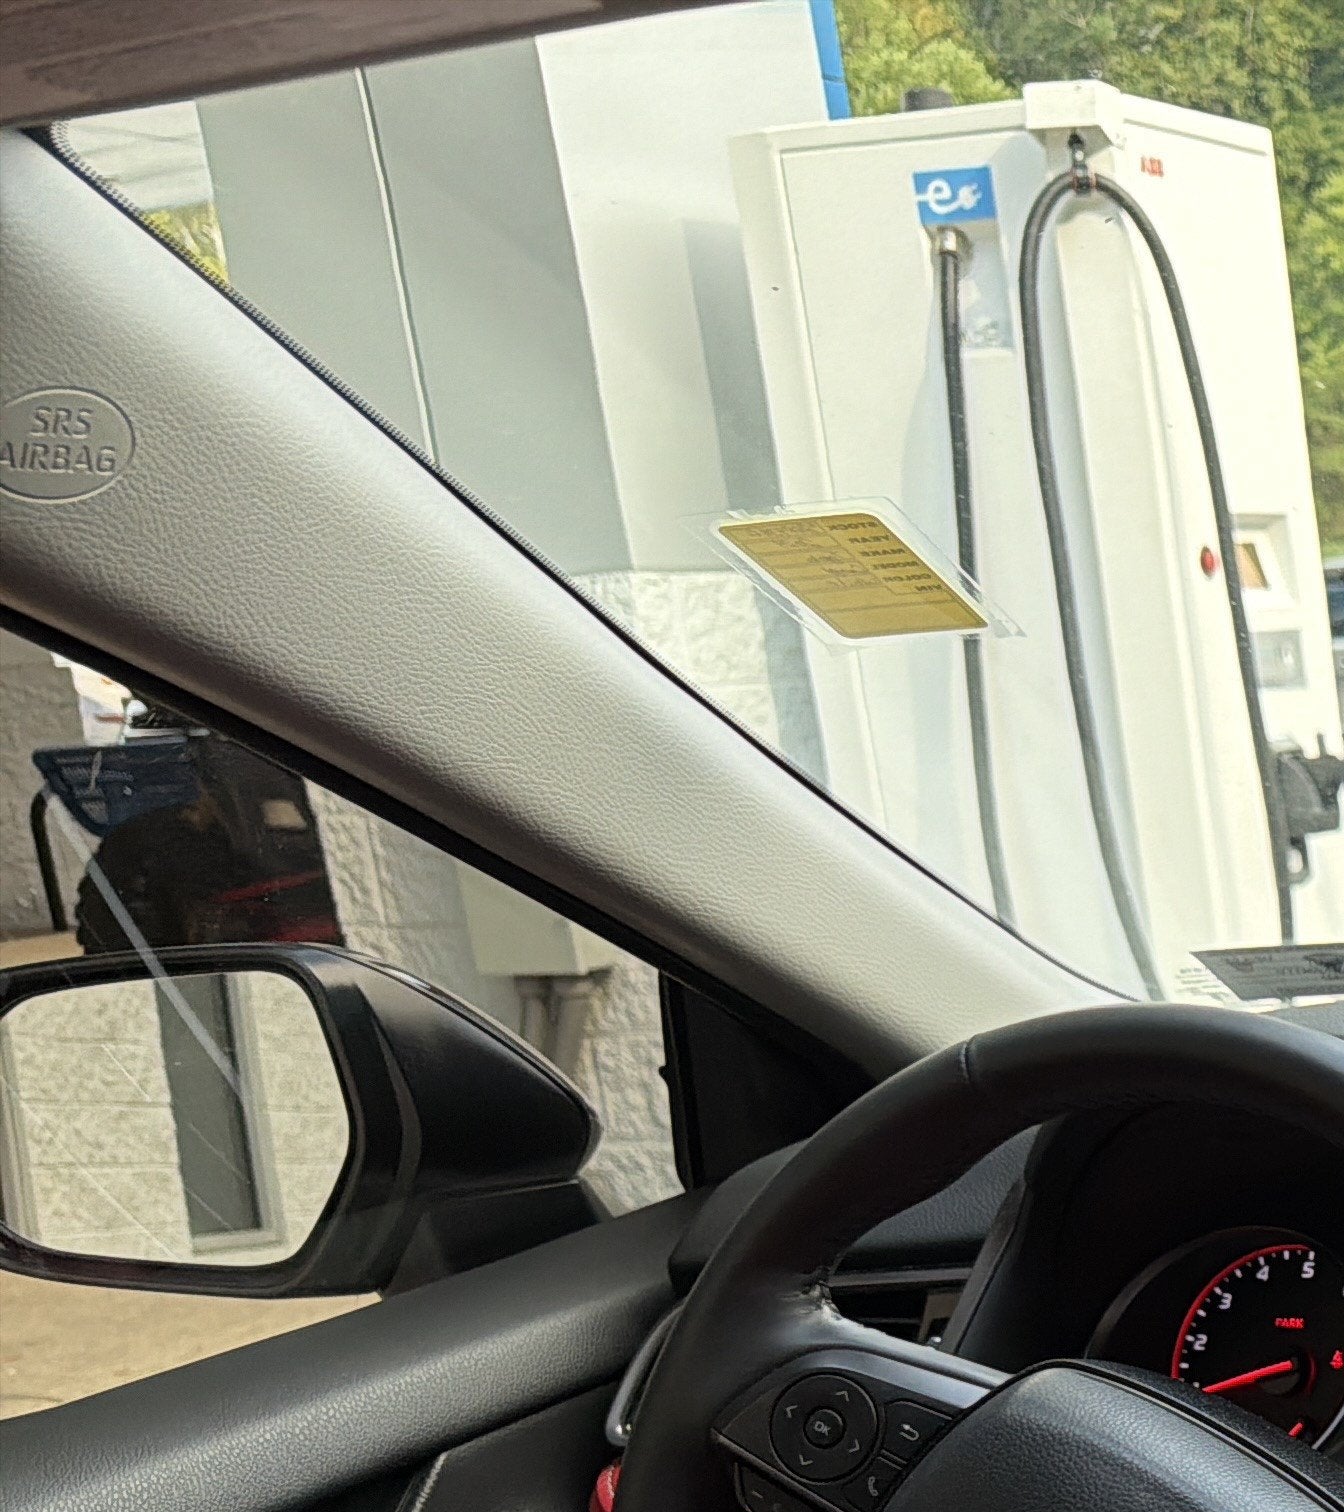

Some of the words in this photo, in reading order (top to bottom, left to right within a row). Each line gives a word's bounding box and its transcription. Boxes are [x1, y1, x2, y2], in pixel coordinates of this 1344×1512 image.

[30, 405, 94, 438] SRS
[0, 441, 116, 476] AIRBAG
[1256, 1265, 1269, 1282] 4
[1301, 1261, 1315, 1278] 5
[1218, 1292, 1232, 1309] 3
[1193, 1334, 1208, 1351] 2
[813, 1420, 831, 1437] OK
